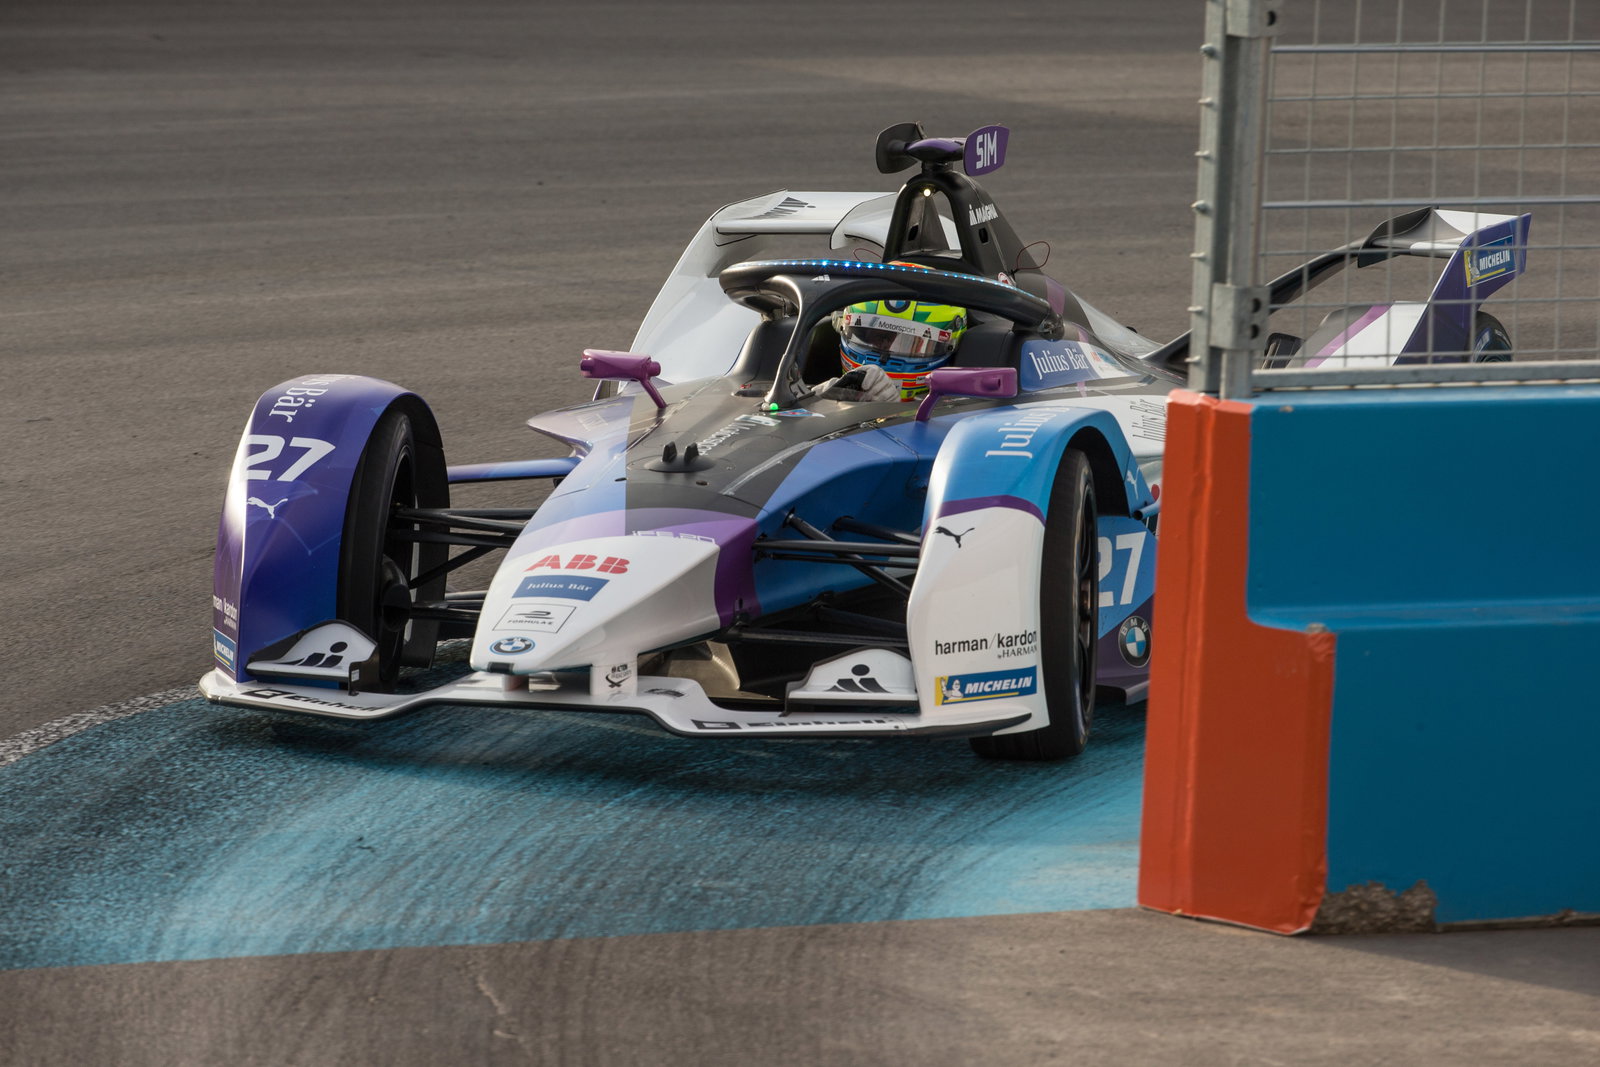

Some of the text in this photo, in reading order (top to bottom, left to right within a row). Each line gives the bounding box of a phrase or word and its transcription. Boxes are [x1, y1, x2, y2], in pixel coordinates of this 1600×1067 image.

[975, 130, 998, 170] SIM
[1479, 249, 1511, 271] MICHELIN
[877, 320, 917, 335] Motorsport
[1029, 350, 1070, 381] Julius
[1064, 347, 1089, 371] Bär
[268, 387, 329, 423] Bär
[244, 434, 337, 483] 27
[523, 554, 631, 575] ABB
[526, 582, 593, 592] Julius Bär
[964, 676, 1033, 695] MICHELIN
